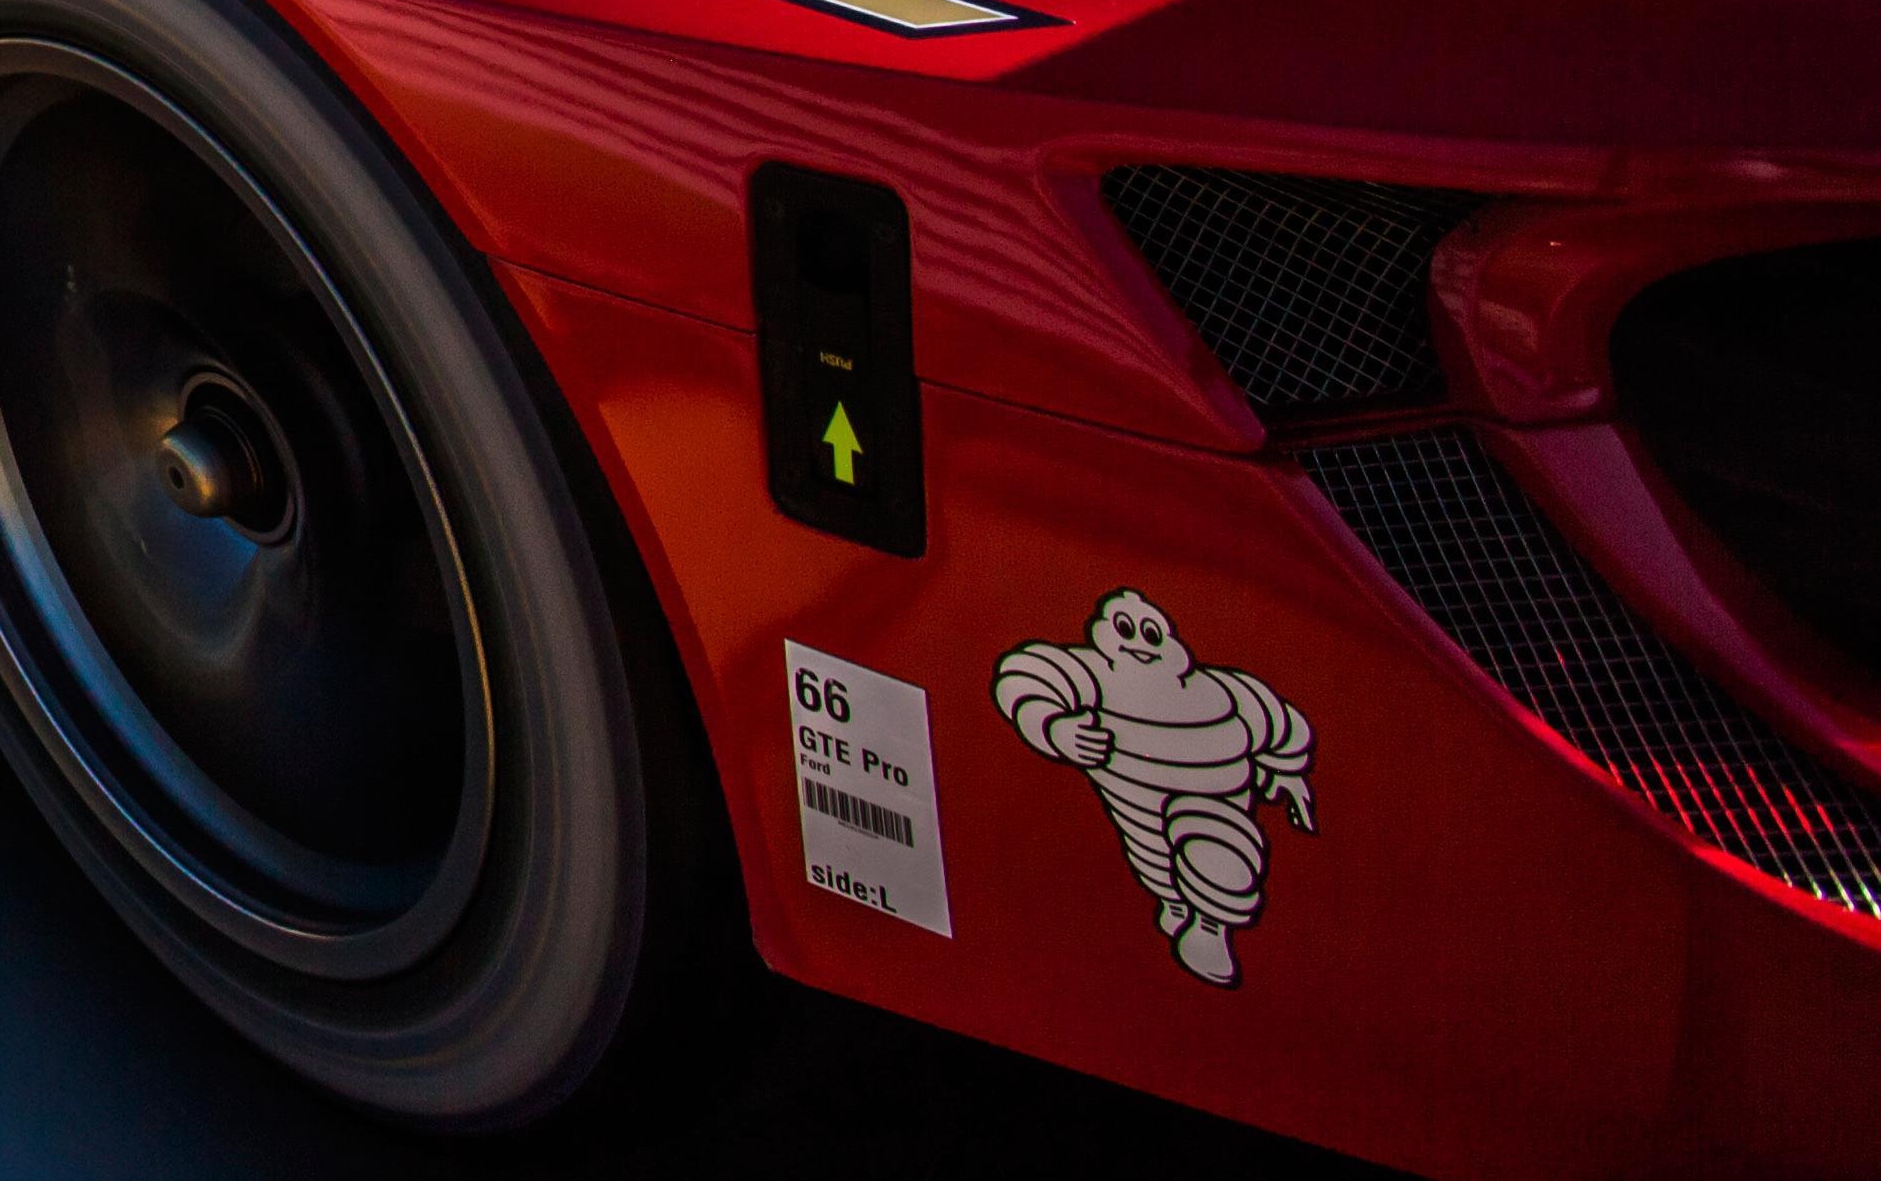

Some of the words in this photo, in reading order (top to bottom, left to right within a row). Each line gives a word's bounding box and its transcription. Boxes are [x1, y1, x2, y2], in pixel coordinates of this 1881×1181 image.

[794, 666, 852, 725] 66
[798, 724, 852, 767] GTE
[861, 747, 910, 789] Pro
[799, 752, 832, 777] Ford
[810, 863, 898, 915] side:L
